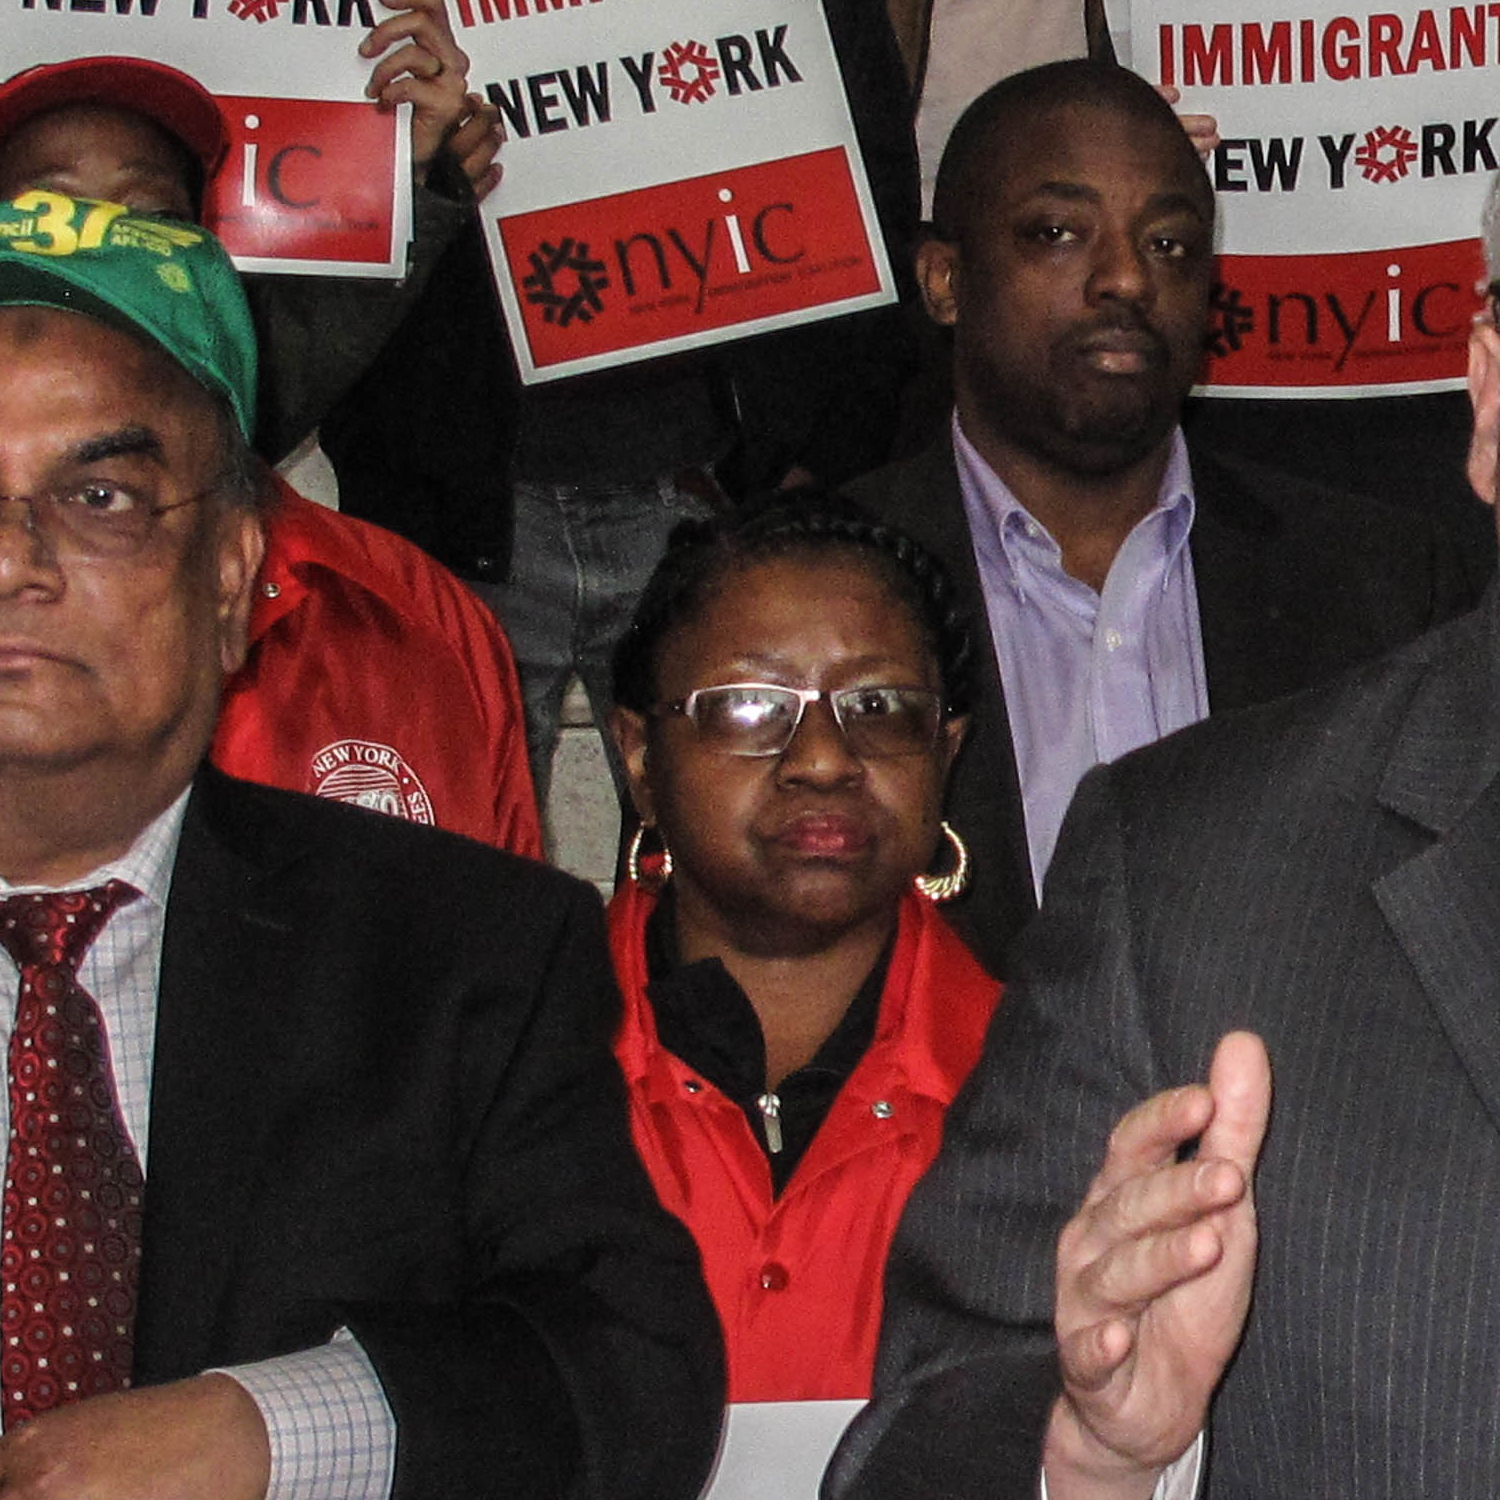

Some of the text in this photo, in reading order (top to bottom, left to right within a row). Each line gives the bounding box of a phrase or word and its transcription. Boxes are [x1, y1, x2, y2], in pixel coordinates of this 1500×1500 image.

[487, 62, 613, 142] NEW
[241, 114, 324, 210] ic
[1206, 135, 1303, 192] EW
[11, 189, 128, 257] 37
[614, 187, 805, 314] nyic
[1267, 263, 1462, 373] nyic
[311, 745, 402, 778] NEW YORK
